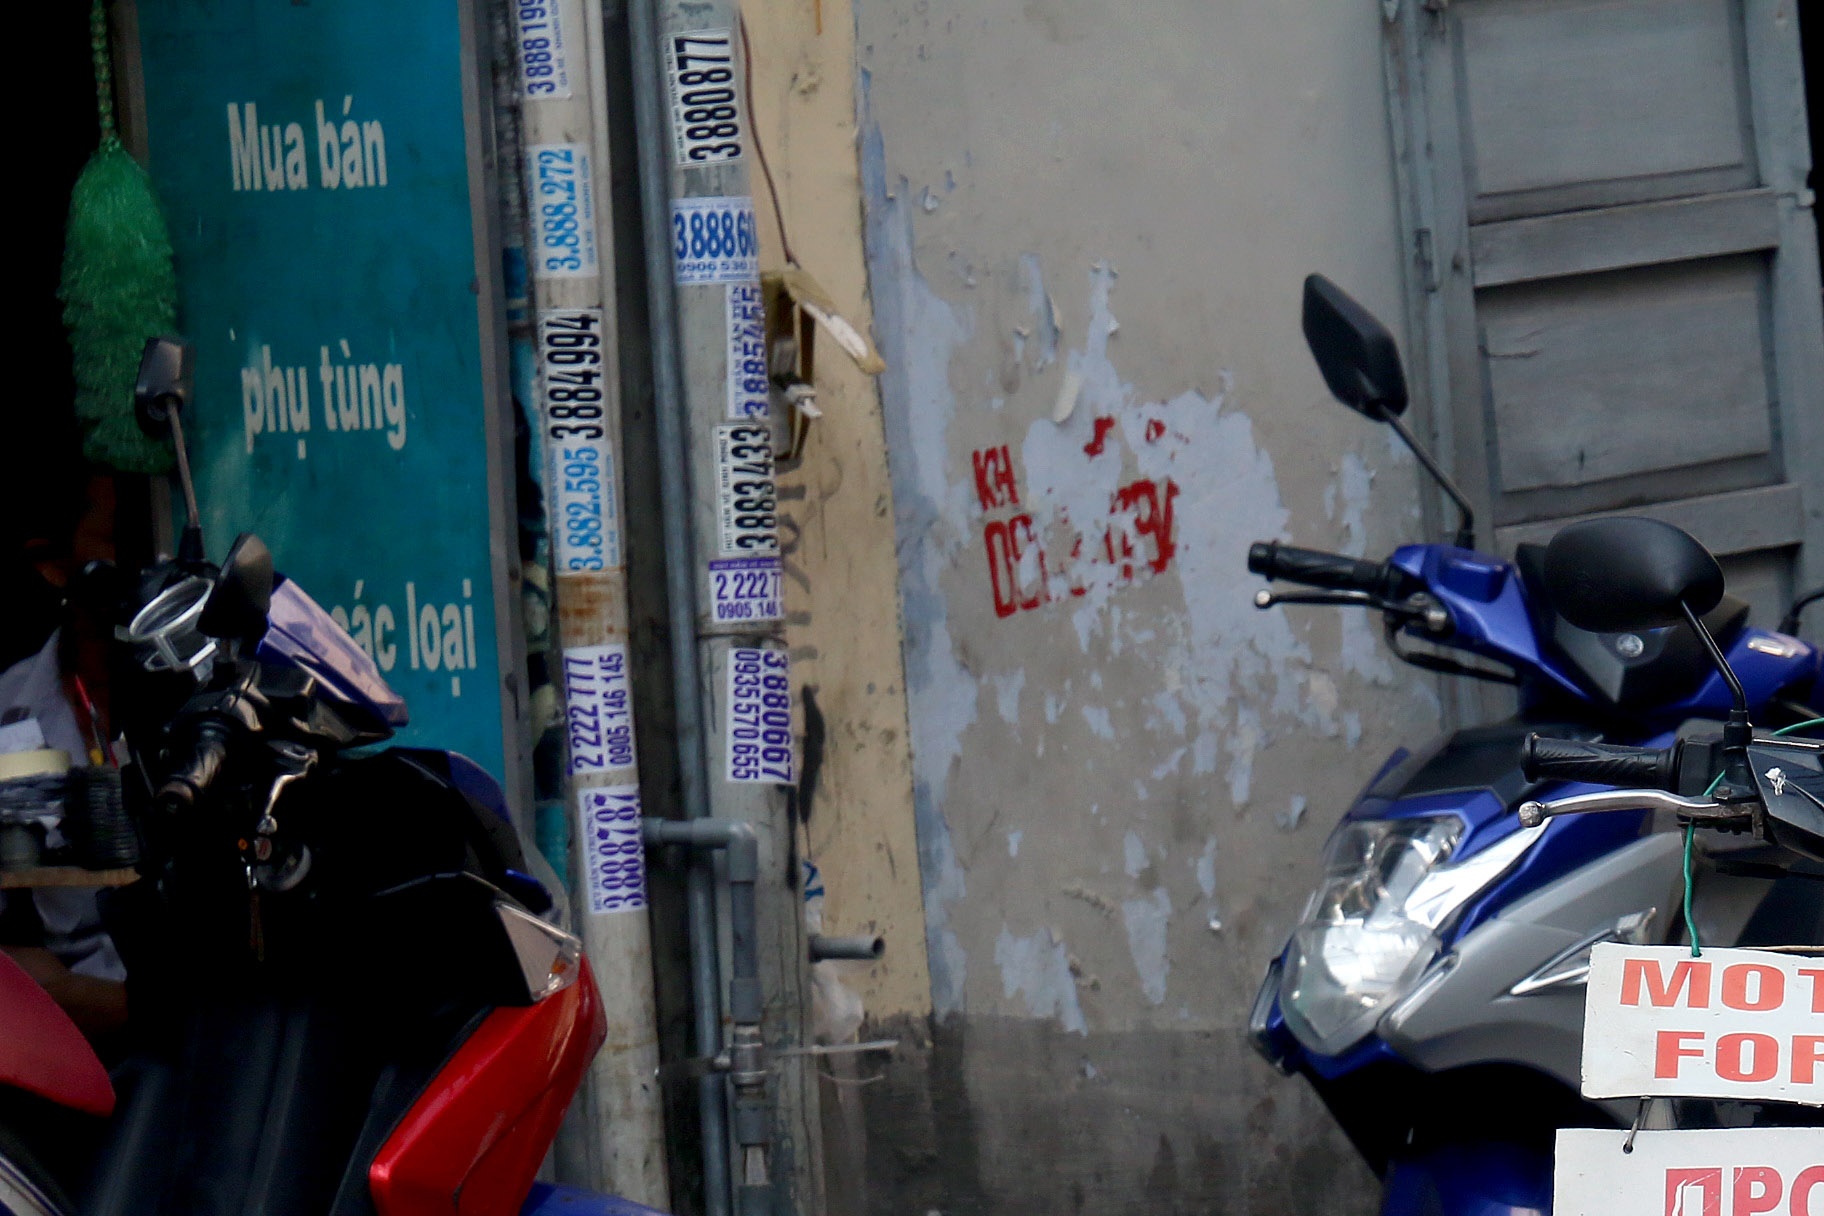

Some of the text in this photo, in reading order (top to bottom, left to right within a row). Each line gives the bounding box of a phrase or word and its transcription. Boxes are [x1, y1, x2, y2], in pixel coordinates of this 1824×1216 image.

[227, 95, 388, 191] Mua bán
[538, 149, 581, 271] 3.888.272
[241, 339, 406, 459] phụ tùng
[545, 314, 604, 440] 3884994
[563, 446, 604, 571] 3.882.595
[730, 426, 778, 550] 3883433
[406, 578, 477, 697] loại
